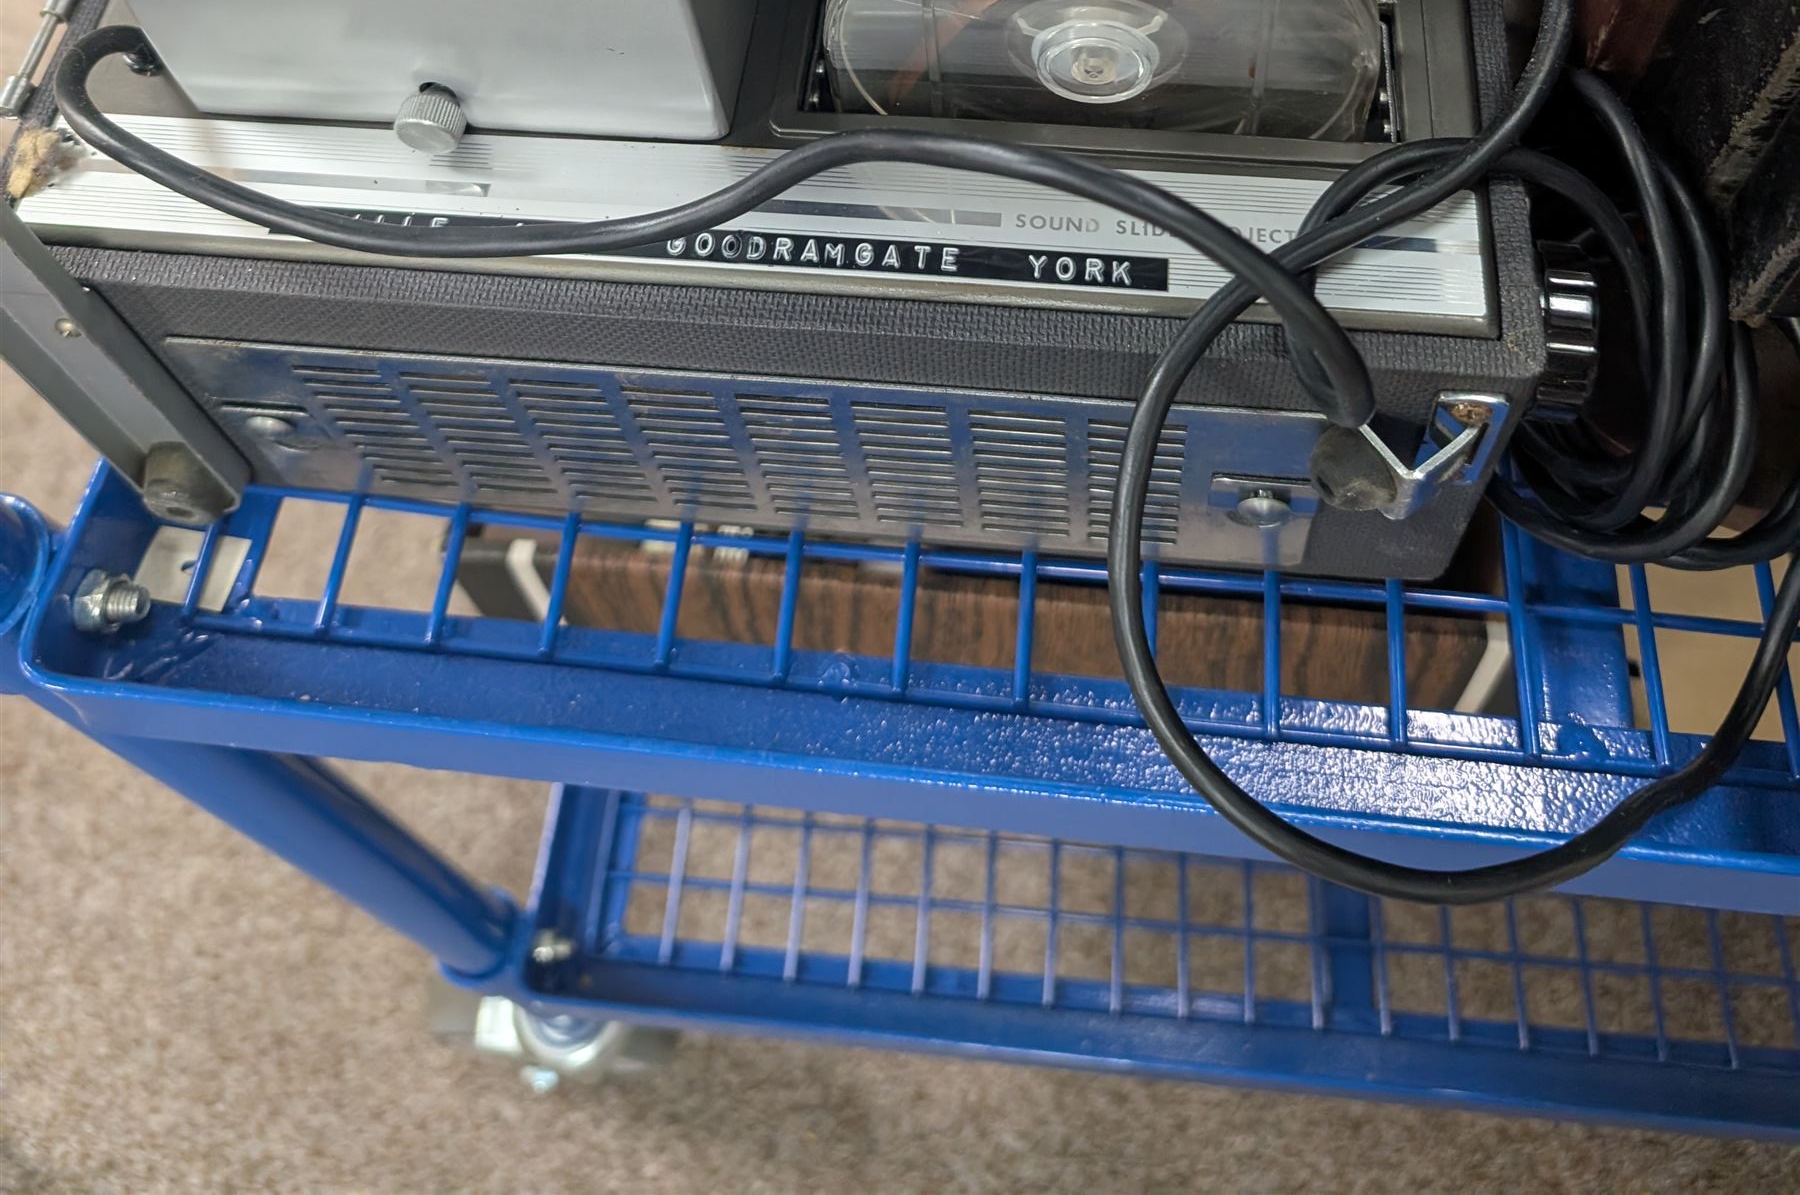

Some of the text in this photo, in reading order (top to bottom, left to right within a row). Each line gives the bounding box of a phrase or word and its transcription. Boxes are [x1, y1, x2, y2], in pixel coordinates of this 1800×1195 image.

[1015, 214, 1100, 233] SOUND
[1115, 219, 1174, 237] SLID
[666, 232, 1133, 286] GOODRAMGATE YORK
